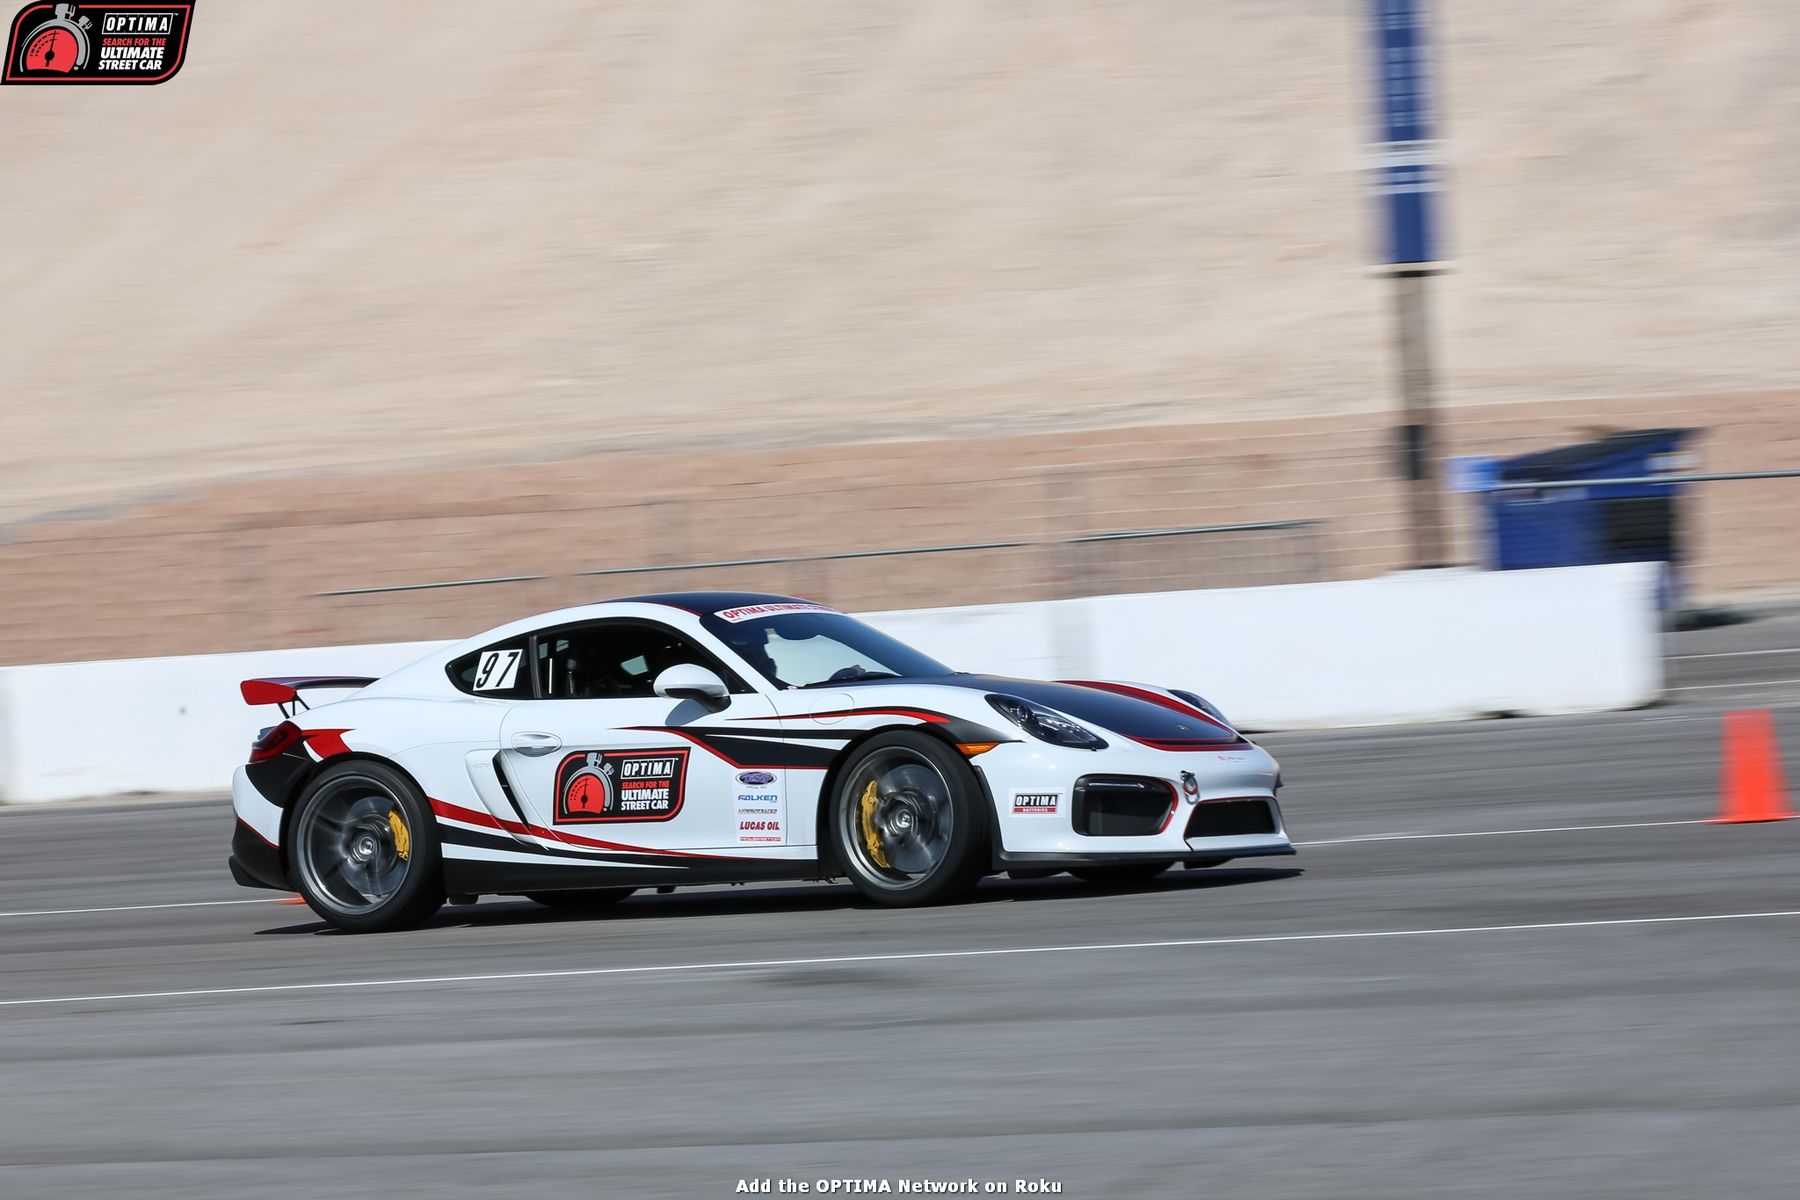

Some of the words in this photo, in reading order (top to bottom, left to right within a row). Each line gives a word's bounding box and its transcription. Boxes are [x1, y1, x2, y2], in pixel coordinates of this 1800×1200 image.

[722, 606, 768, 619] OPTIMA
[475, 651, 520, 689] 97
[623, 761, 671, 776] OPTIMA
[622, 781, 644, 789] SEARCH
[658, 780, 670, 788] THE
[621, 788, 670, 801] ULTIMATE
[1015, 795, 1056, 806] OPTIMA
[620, 800, 651, 811] STREET
[651, 799, 669, 810] CAR
[740, 821, 765, 831] LUCAS
[766, 821, 780, 831] OIL
